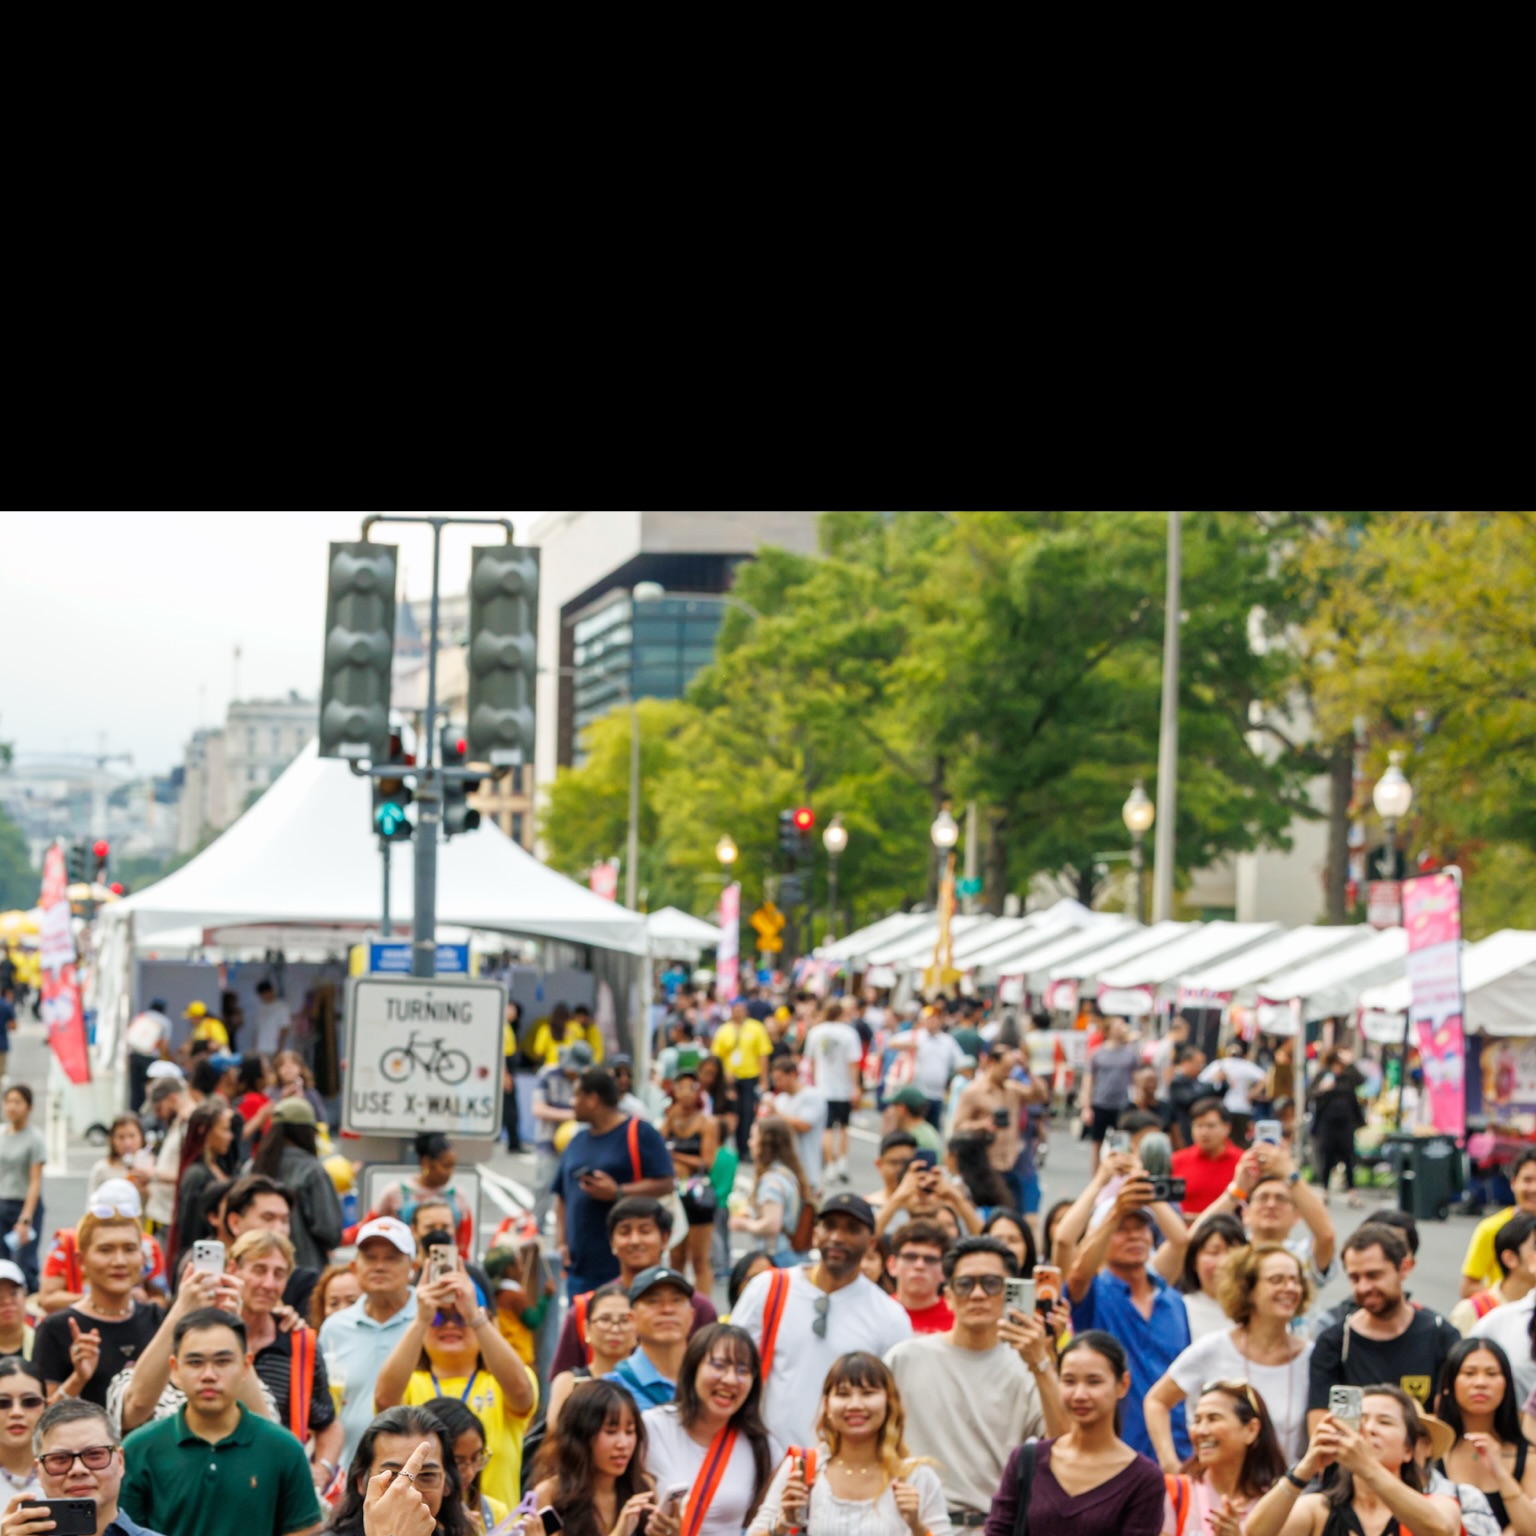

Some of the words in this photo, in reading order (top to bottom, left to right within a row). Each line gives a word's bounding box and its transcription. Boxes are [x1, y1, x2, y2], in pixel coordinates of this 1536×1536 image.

[385, 998, 473, 1024] TURNING
[353, 1091, 395, 1115] USE
[403, 1093, 494, 1119] X-WALKS
